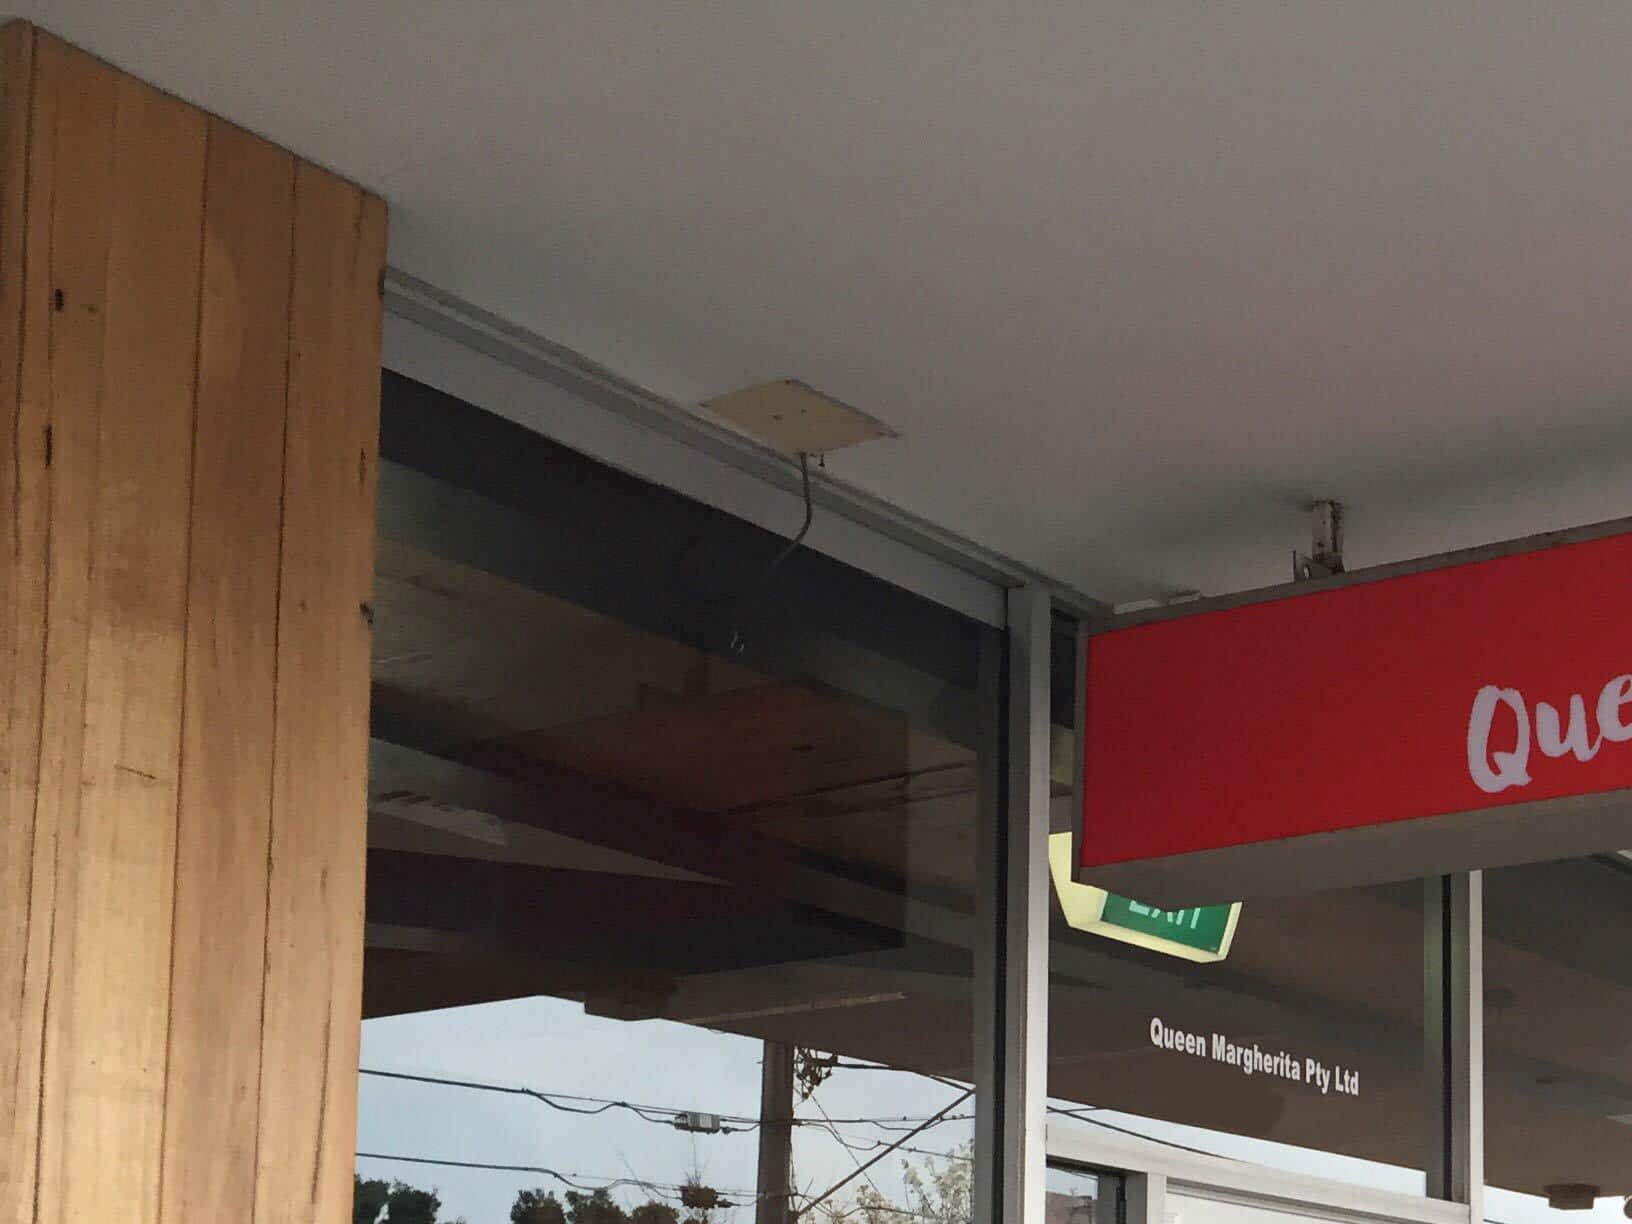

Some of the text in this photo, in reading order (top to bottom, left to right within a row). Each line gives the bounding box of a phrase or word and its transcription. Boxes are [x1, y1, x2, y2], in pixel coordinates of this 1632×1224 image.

[1150, 1017, 1360, 1096] Queen Margherita Pty Ltd
